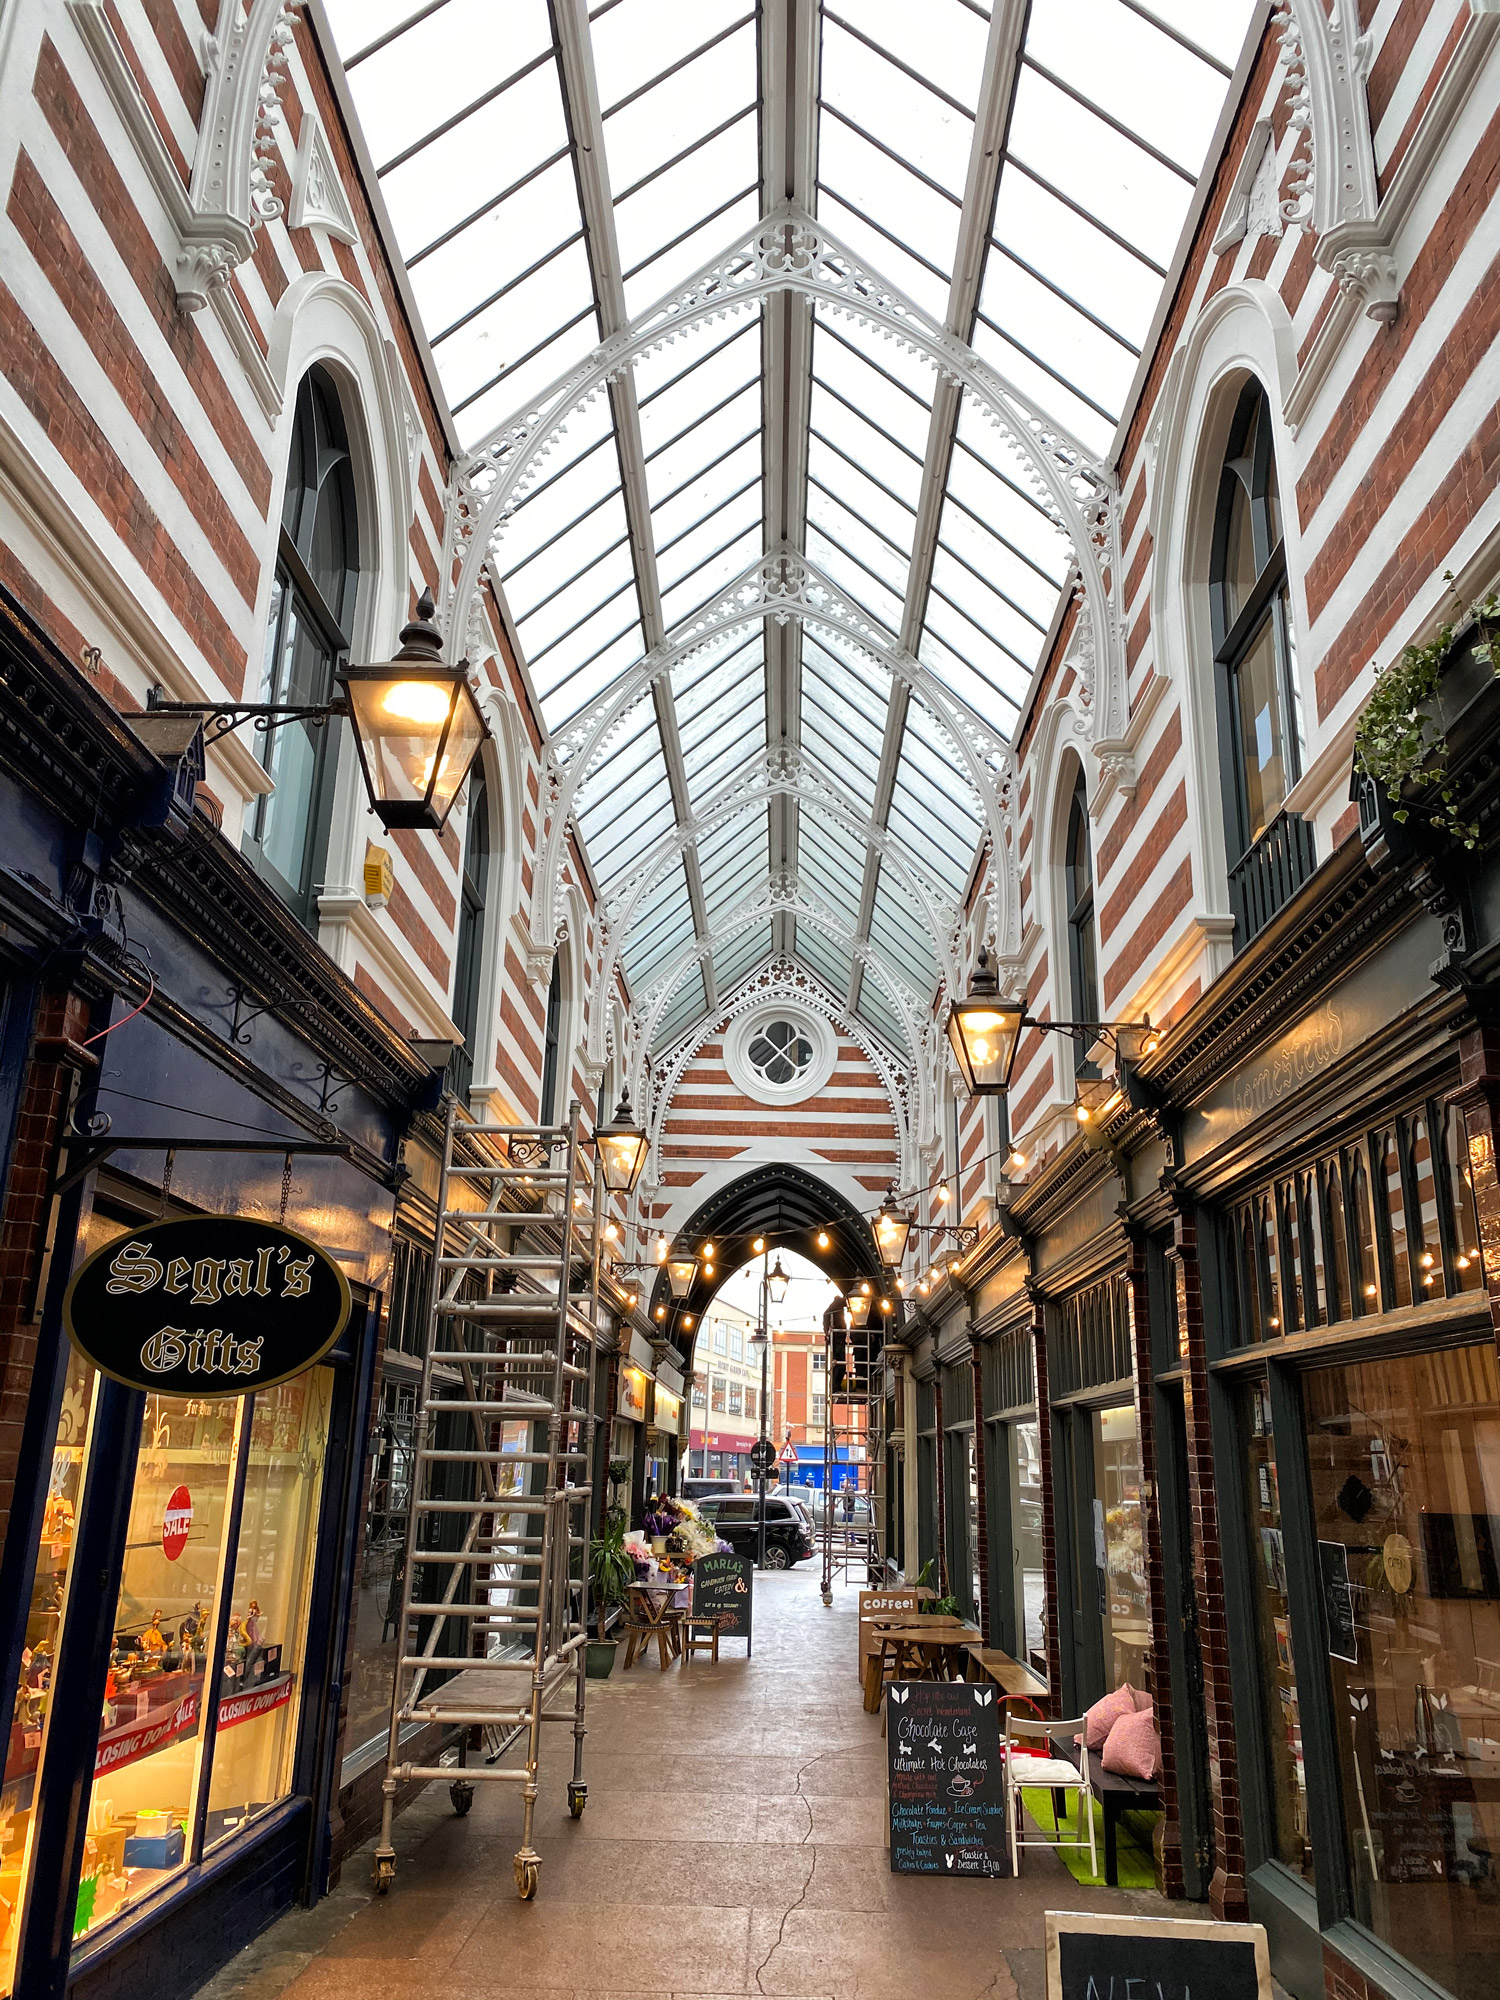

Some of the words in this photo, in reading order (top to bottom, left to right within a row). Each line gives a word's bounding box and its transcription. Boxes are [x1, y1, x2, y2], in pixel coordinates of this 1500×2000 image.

[1233, 1000, 1342, 1124] homestead
[106, 1241, 314, 1305] Segal's
[140, 1325, 264, 1375] Gifts
[163, 1517, 190, 1538] SALE
[703, 1558, 744, 1574] MARLA'S
[734, 1577, 748, 1593] &
[220, 1698, 254, 1723] CLOSING
[898, 1716, 948, 1742] Chocolate
[952, 1718, 978, 1743] Cafe
[95, 1734, 142, 1769] LOSING
[894, 1757, 926, 1772] Ultimate
[930, 1756, 946, 1771] Hot
[948, 1756, 988, 1772] Chocolates
[892, 1802, 924, 1817] Chocolate
[924, 1800, 948, 1816] Fondue
[953, 1800, 964, 1814] Ice
[964, 1802, 983, 1816] Cream
[892, 1818, 922, 1832] Milkshakes
[948, 1818, 968, 1833] Coffee
[974, 1819, 987, 1830] Tea
[910, 1830, 938, 1846] Toasties
[940, 1836, 946, 1846] &
[949, 1832, 984, 1847] Sandwiches
[959, 1848, 982, 1860] Toastie
[958, 1858, 980, 1870] Dessert
